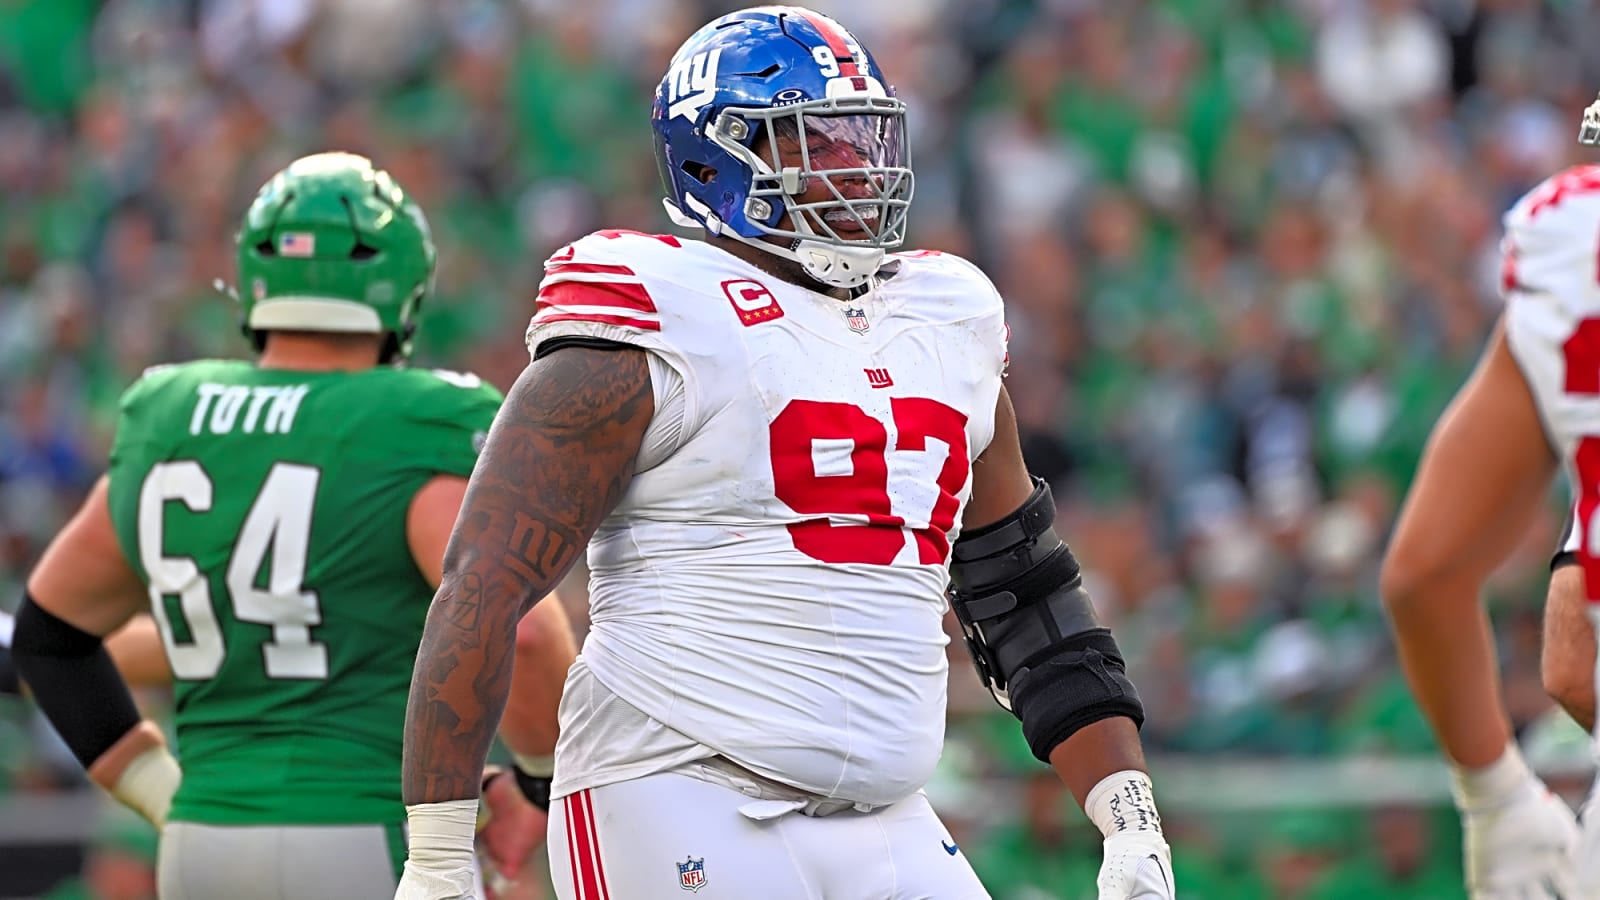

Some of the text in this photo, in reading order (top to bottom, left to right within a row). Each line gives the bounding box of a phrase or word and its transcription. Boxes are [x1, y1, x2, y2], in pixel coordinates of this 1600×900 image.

[727, 282, 773, 311] C
[849, 317, 869, 329] NFL
[189, 383, 309, 435] TOTH
[769, 396, 970, 566] 97
[138, 460, 329, 680] 64
[683, 871, 703, 885] NFL
